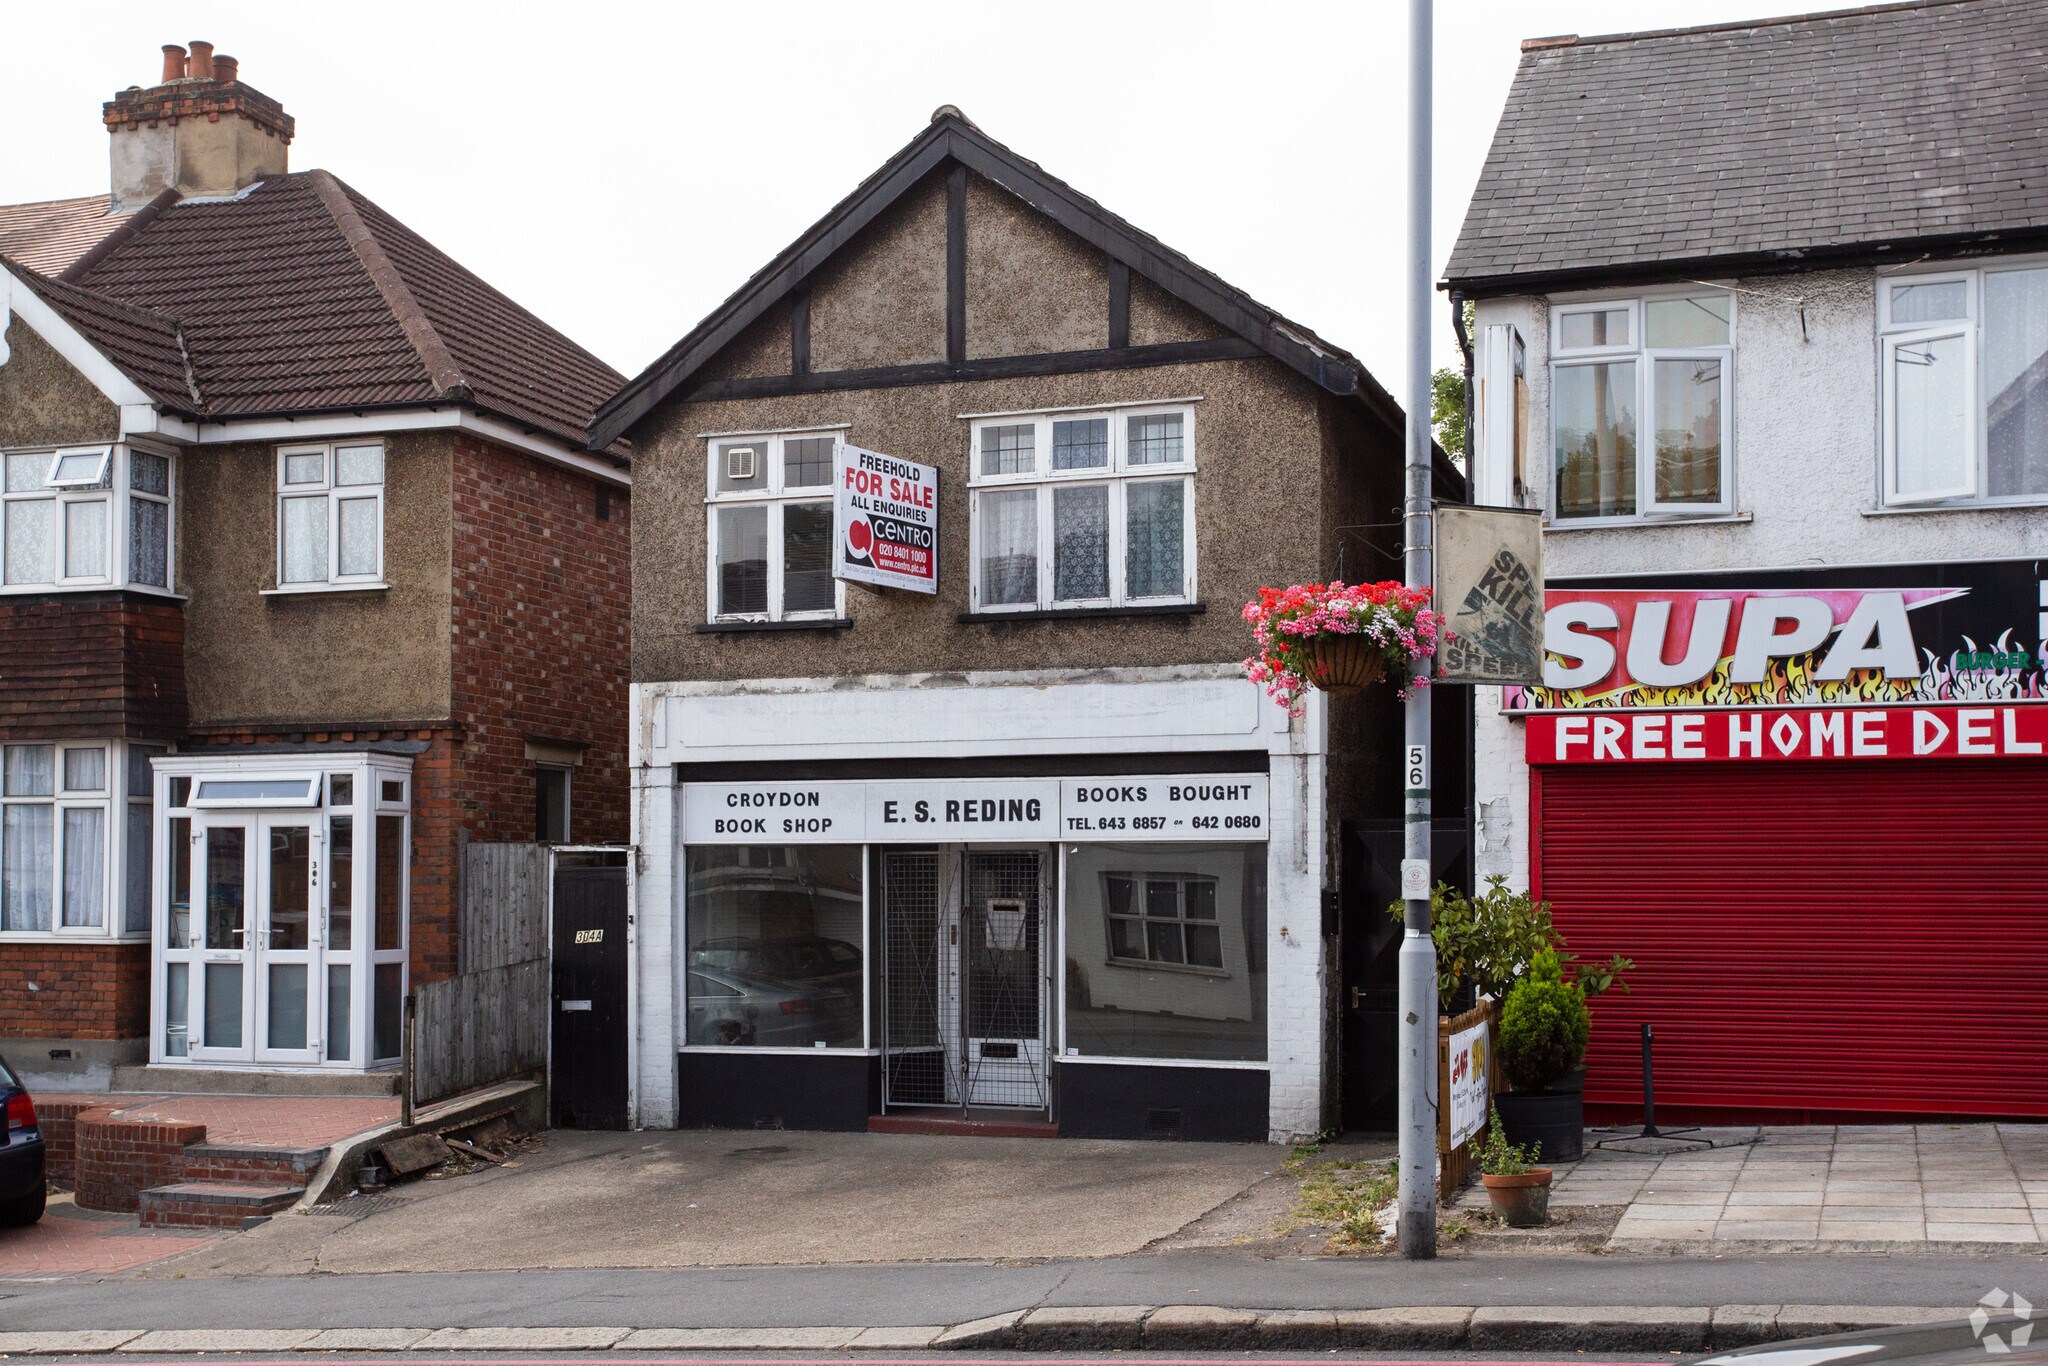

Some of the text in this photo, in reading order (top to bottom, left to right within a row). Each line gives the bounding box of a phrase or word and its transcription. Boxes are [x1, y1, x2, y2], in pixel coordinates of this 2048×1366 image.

[860, 453, 920, 482] FREEHOLD
[845, 467, 933, 509] FOR SALE
[851, 495, 927, 522] ALL ENQUIRIES
[879, 543, 926, 563] 020 8401 1000
[1545, 592, 1922, 689] SUPA
[1955, 651, 2031, 671] BURGER
[1555, 707, 2043, 761] FREE HOME DEL
[726, 792, 820, 807] CROYDON
[1077, 785, 1252, 803] BOOKS BOUGHT
[884, 798, 1041, 823] E. S. REDING
[715, 818, 832, 833] BOOK SHOP
[1067, 817, 1096, 830] TEL.
[1098, 817, 1126, 830] 643
[1132, 816, 1166, 830] 6857
[1191, 816, 1219, 829] 642
[1224, 815, 1261, 829] 0680
[576, 931, 601, 942] 304A
